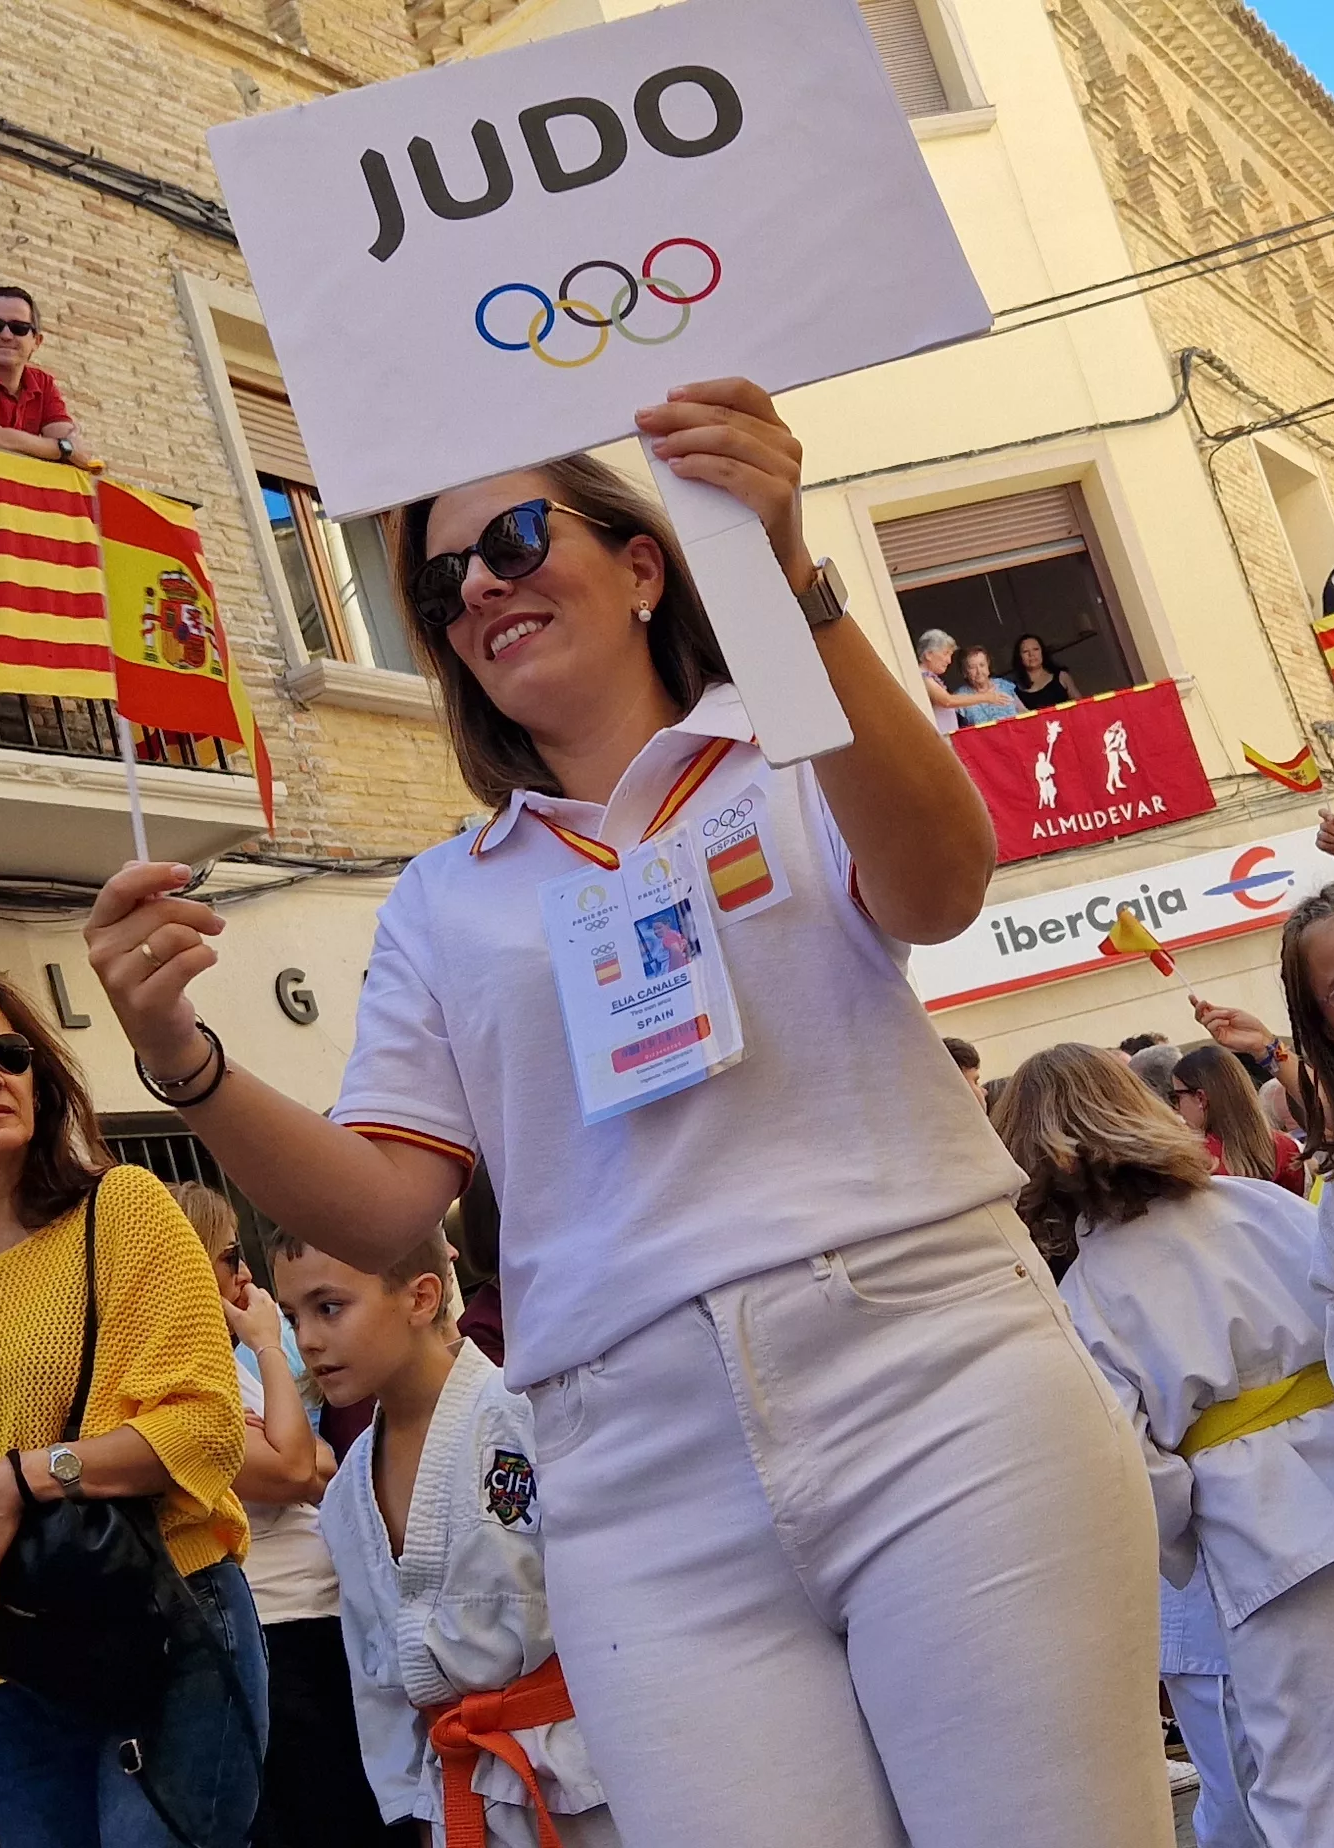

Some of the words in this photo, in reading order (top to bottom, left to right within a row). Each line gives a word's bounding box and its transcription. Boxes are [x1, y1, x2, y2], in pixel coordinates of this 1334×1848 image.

[359, 64, 744, 263] JUDO
[1031, 795, 1167, 840] ALMUDEVAR
[709, 828, 752, 856] ESPAÑA
[990, 883, 1188, 957] iberCaja
[611, 994, 635, 1010] ELIA
[637, 972, 688, 999] CANALES
[637, 1008, 674, 1030] SPAIN
